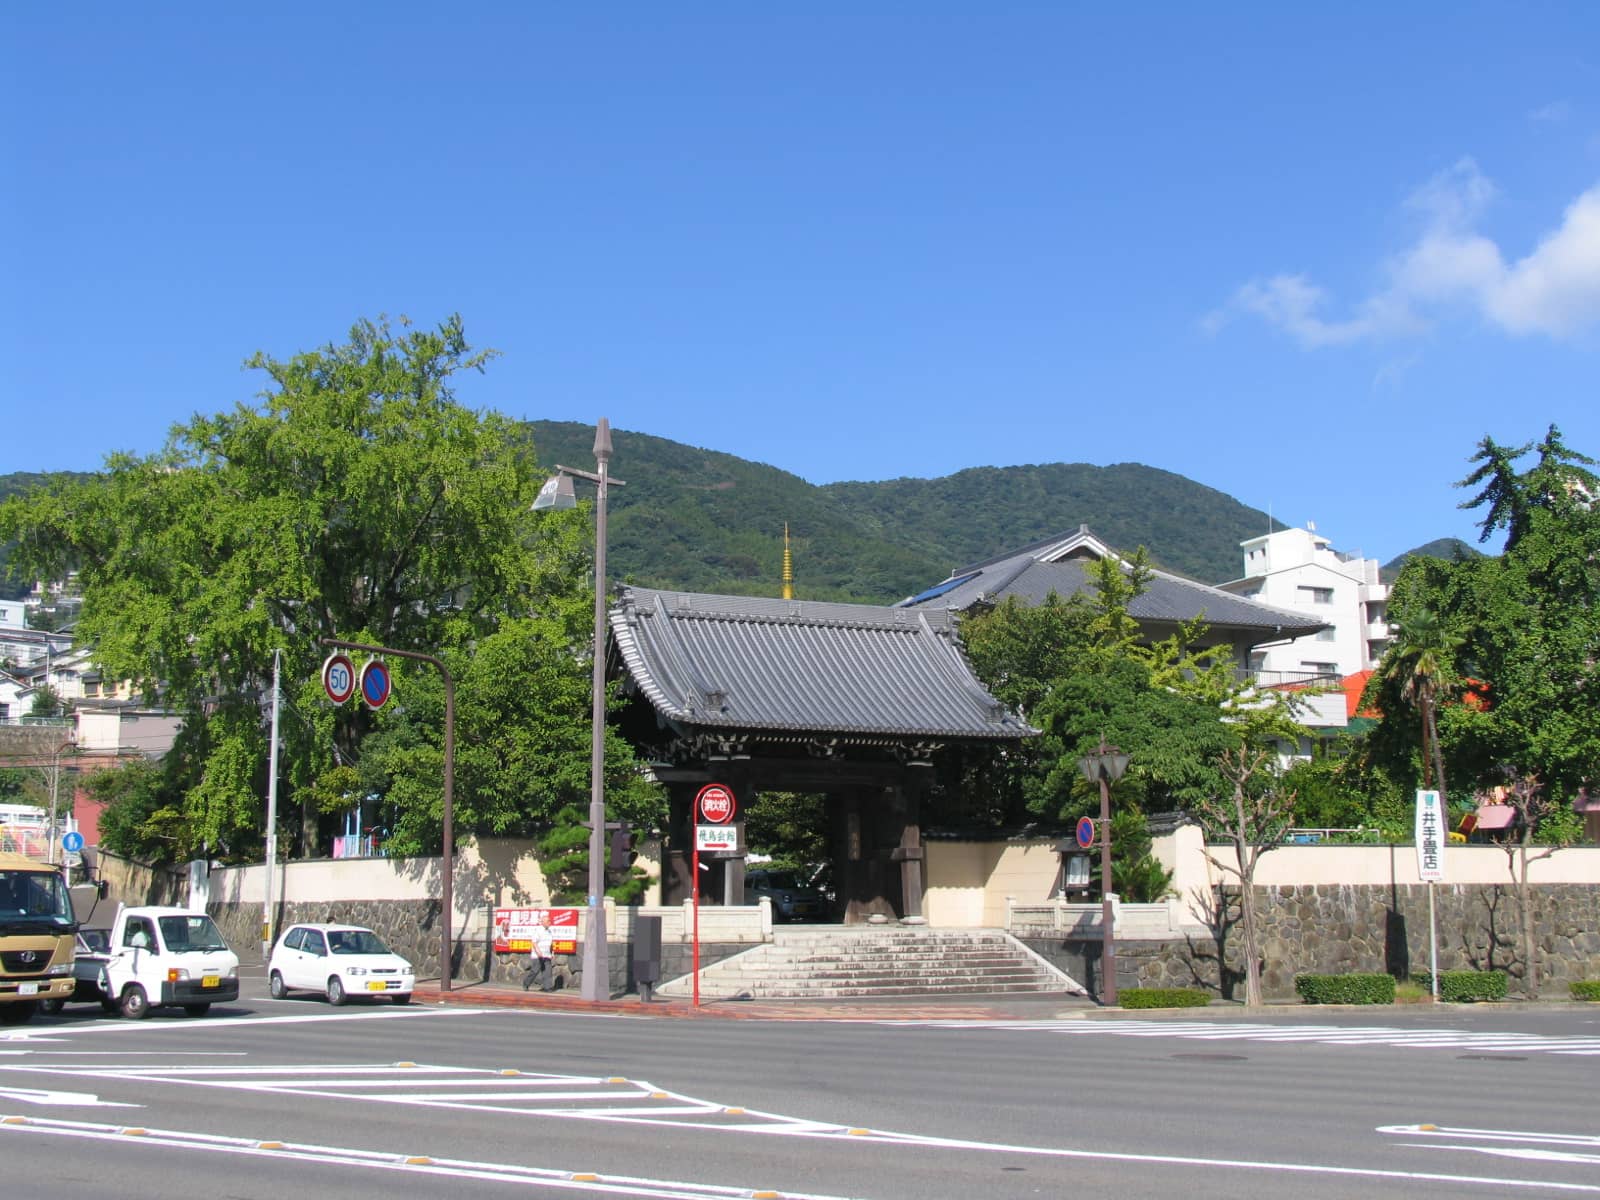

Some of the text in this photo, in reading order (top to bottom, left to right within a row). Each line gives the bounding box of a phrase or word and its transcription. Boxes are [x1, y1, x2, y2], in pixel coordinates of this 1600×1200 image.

[331, 668, 348, 689] 50
[703, 799, 728, 812] 消火栓
[1422, 810, 1438, 870] 井手畳店
